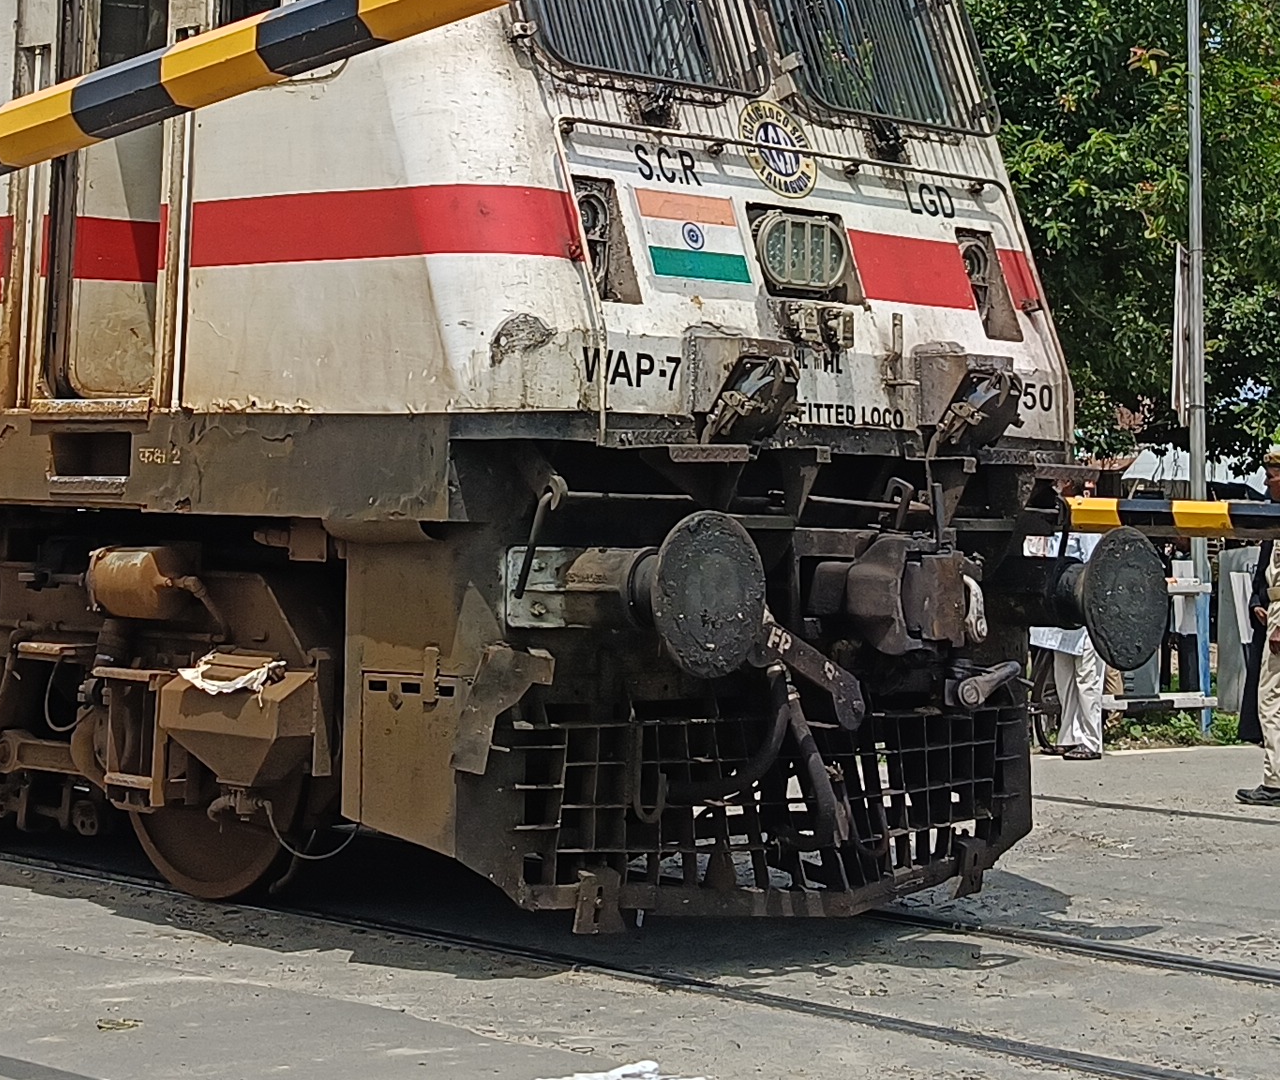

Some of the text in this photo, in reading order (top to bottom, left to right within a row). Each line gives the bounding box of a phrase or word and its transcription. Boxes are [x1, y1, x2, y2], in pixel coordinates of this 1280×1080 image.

[742, 105, 764, 154] EECTRIC
[763, 105, 790, 128] LOCO
[634, 143, 703, 187] S.C.R
[759, 165, 812, 194] LALLAGUDA
[902, 180, 955, 219] LGD
[582, 346, 682, 391] WAP-7
[796, 402, 904, 428] FITTED LOCO
[138, 448, 181, 465] कक्ष 2
[766, 626, 793, 655] FP
